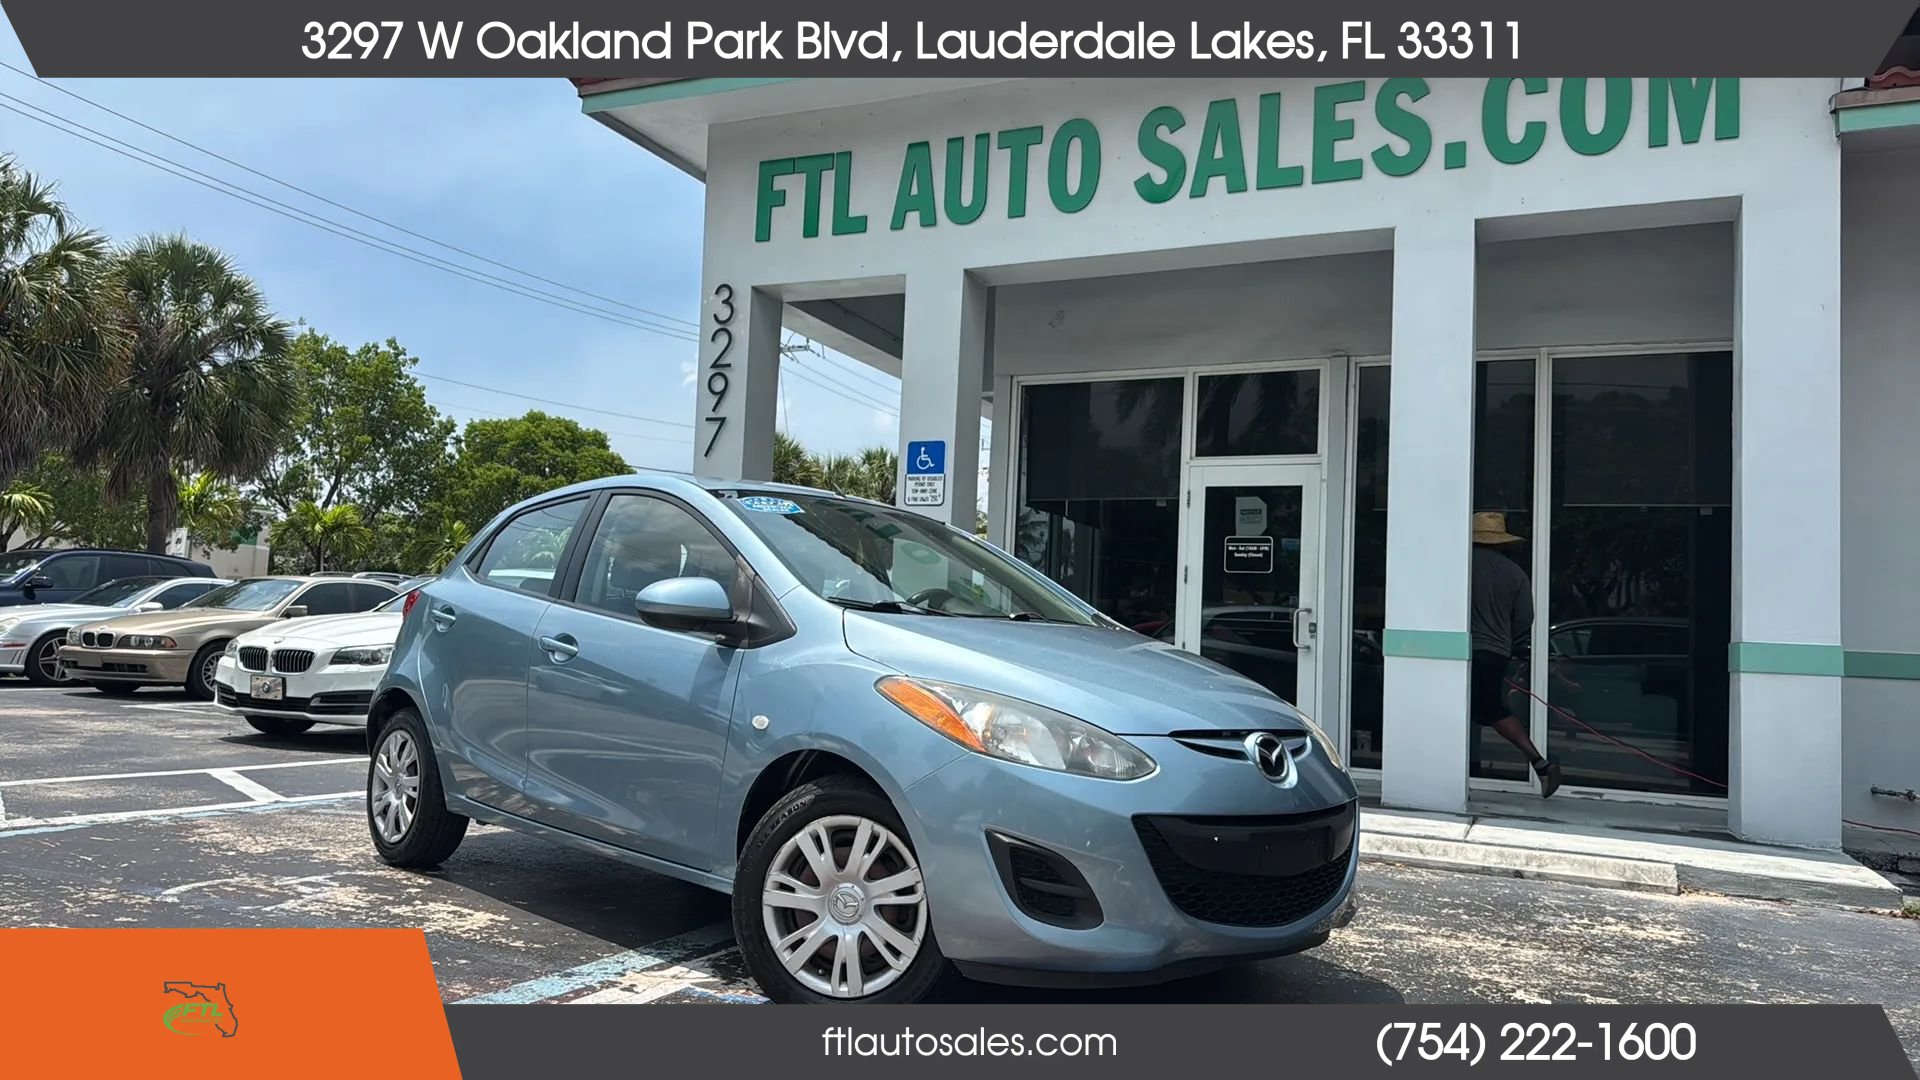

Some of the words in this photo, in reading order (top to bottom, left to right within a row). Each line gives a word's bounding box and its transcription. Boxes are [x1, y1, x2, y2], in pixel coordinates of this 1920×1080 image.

[755, 152, 868, 243] FTL
[890, 118, 1101, 232] AUTO
[704, 283, 735, 458] 3297
